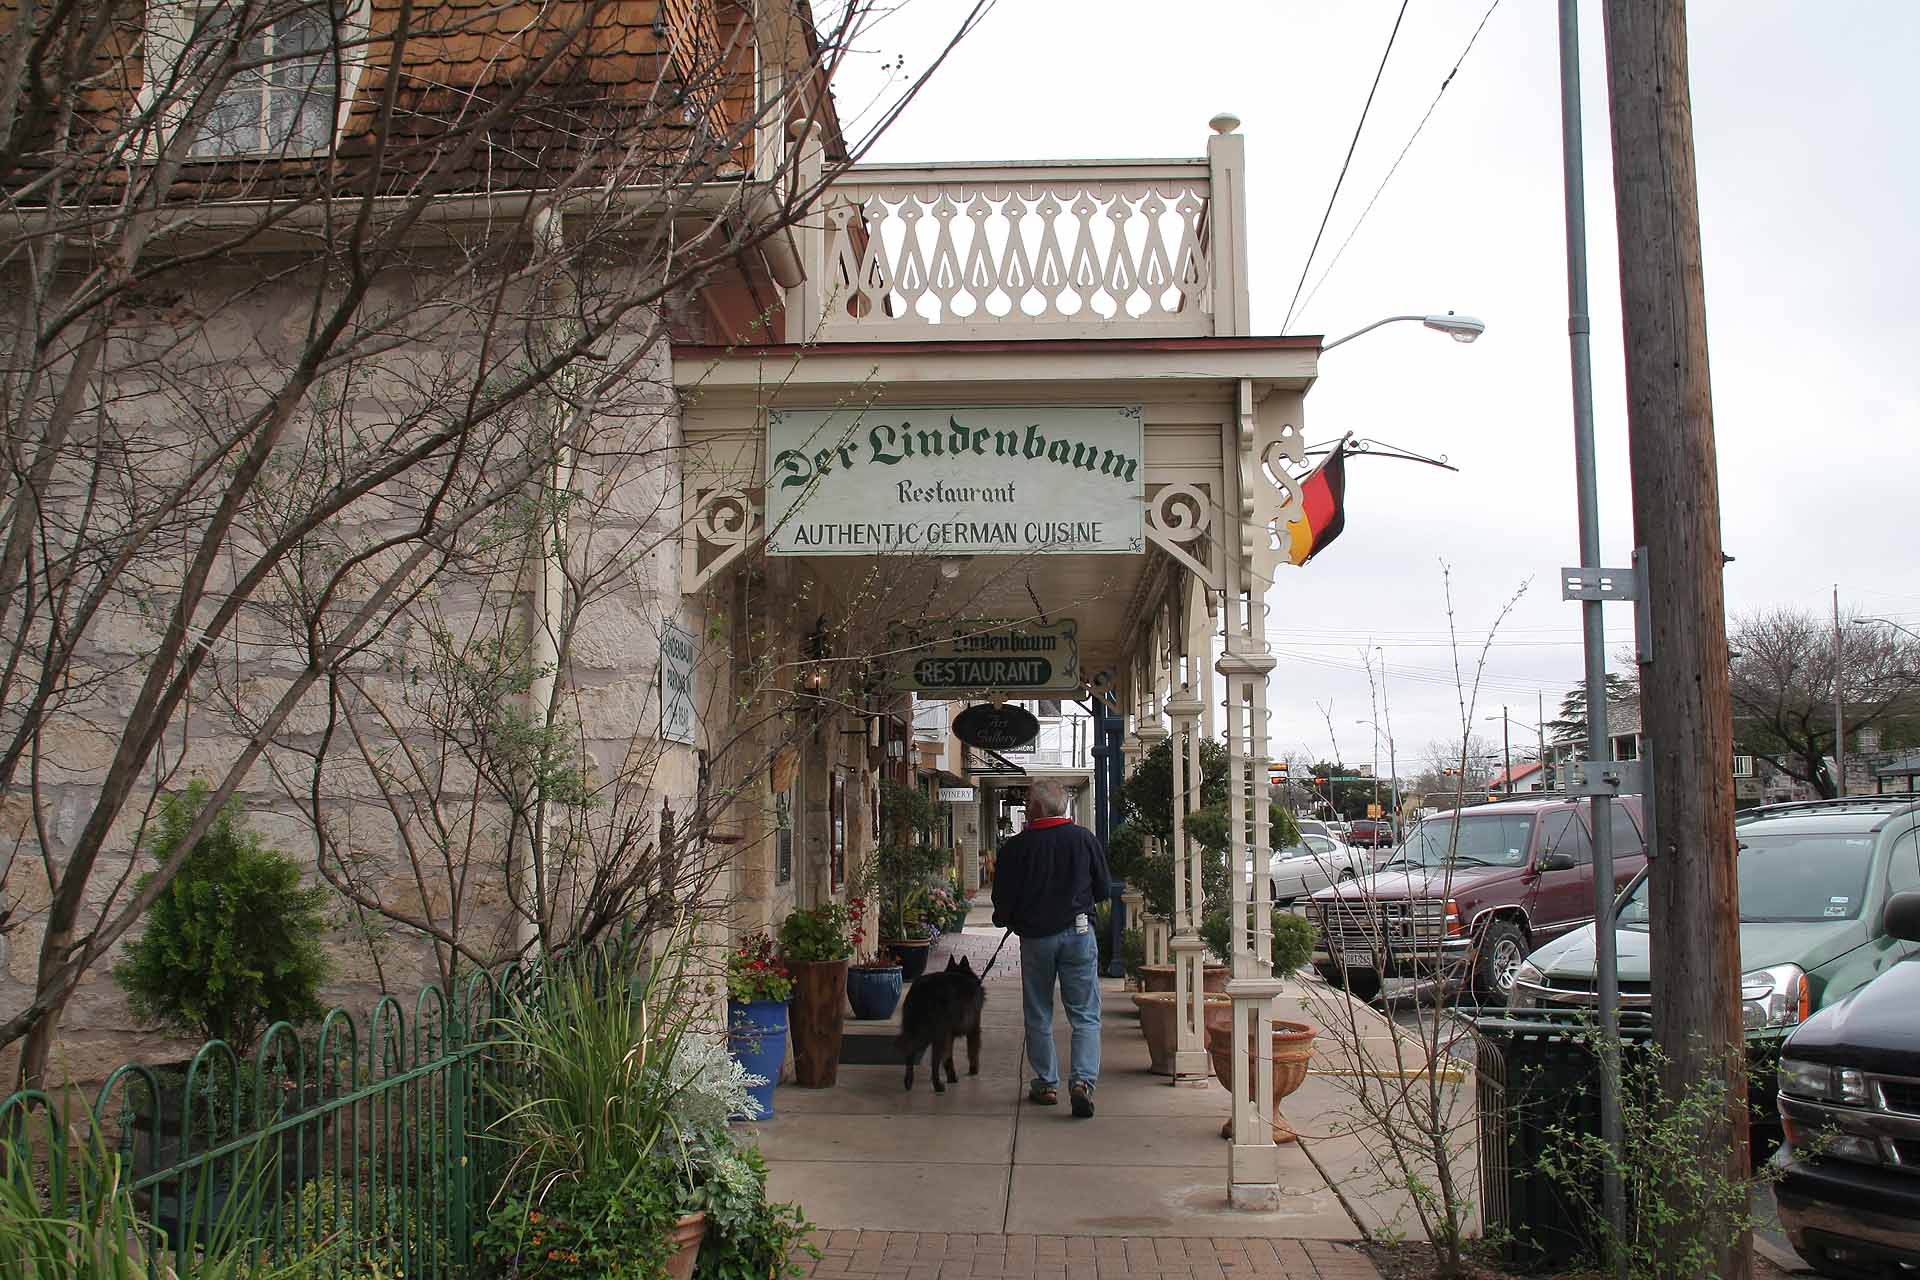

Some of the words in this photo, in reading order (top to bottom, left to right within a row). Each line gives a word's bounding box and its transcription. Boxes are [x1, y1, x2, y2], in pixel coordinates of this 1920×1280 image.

[773, 440, 859, 492] Der
[868, 414, 1139, 484] Lindenbaum
[896, 479, 1017, 504] Restaurant
[794, 523, 920, 546] AUTHENTIC
[926, 522, 1018, 545] GERMAN
[1024, 521, 1103, 545] CUISINE
[922, 661, 1042, 682] RESTAURANT
[940, 790, 971, 799] WINERY
